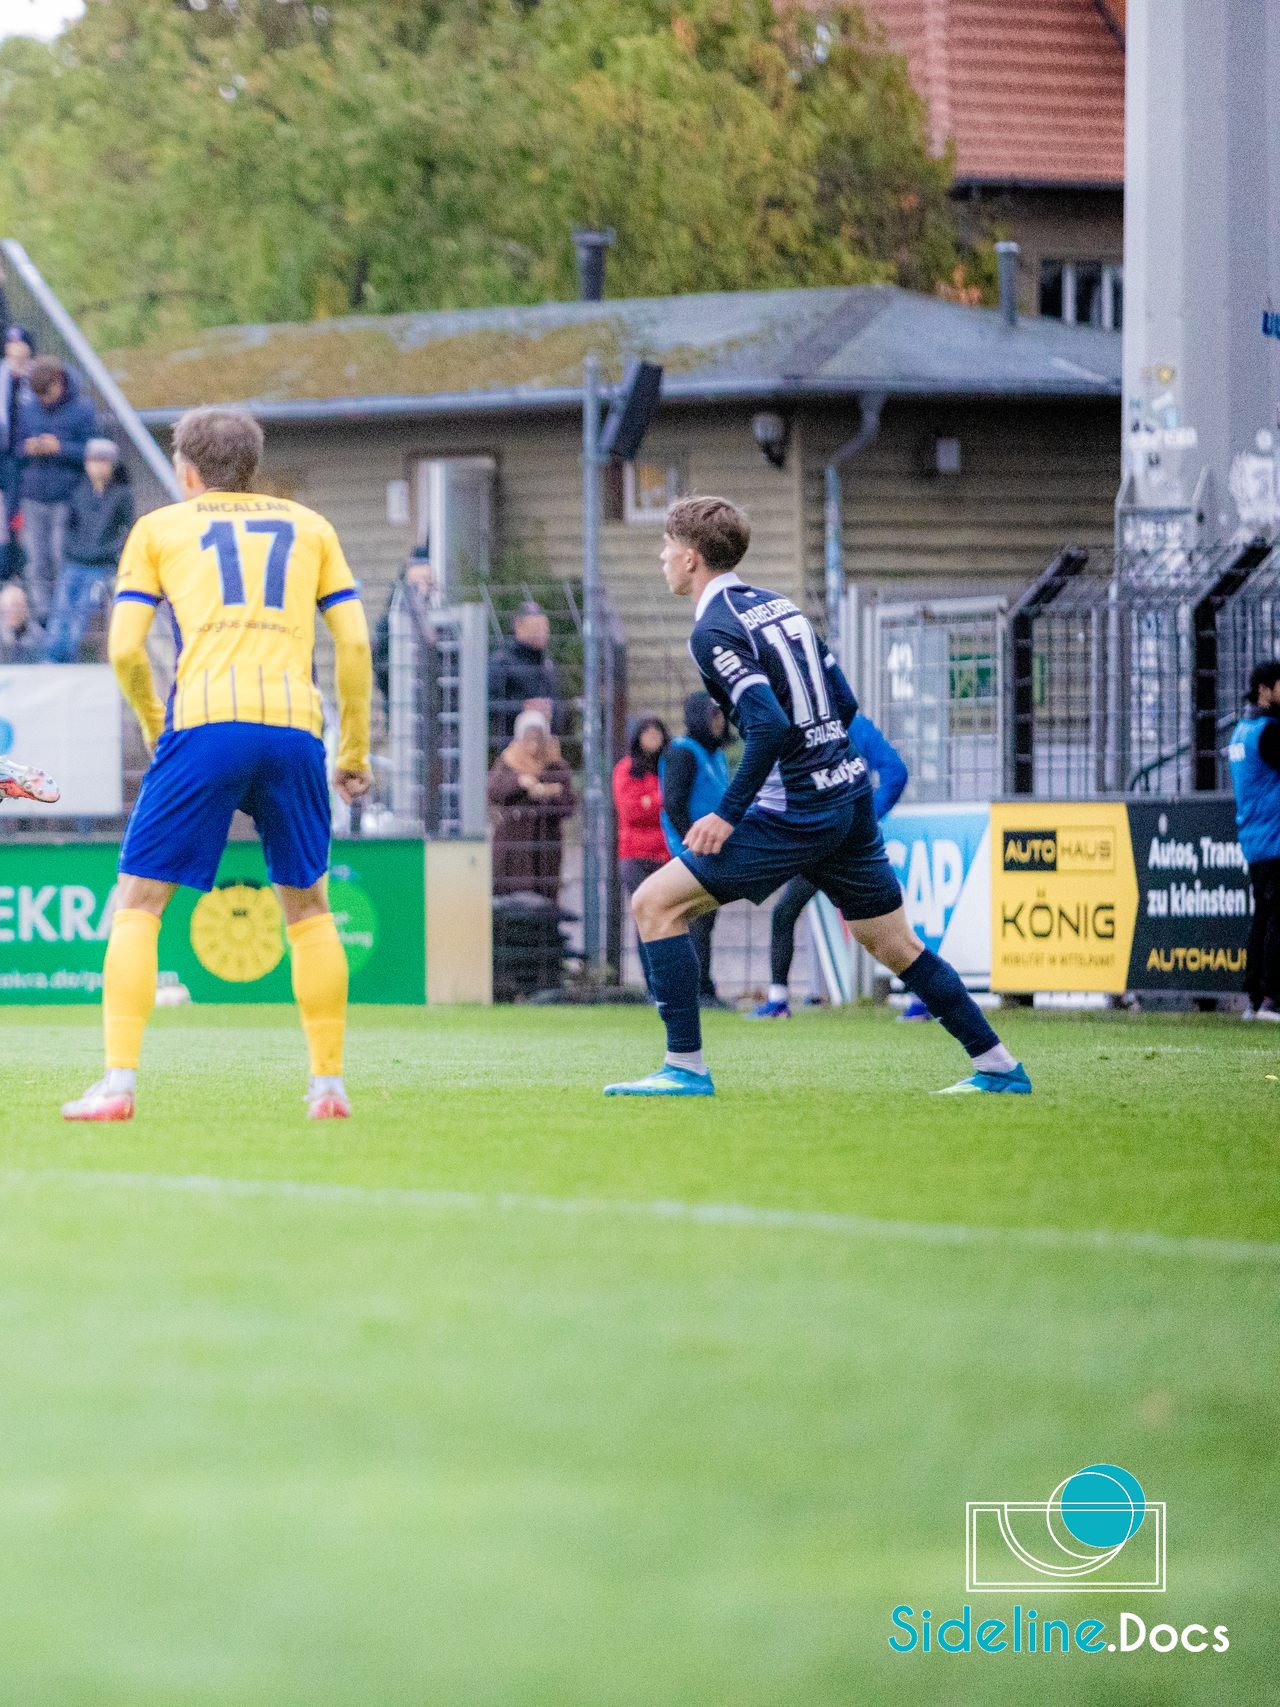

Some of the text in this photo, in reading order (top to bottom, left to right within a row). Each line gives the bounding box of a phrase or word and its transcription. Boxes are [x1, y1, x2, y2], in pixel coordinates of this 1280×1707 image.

[200, 520, 295, 610] 17
[739, 598, 800, 631] BABELSBE
[760, 615, 831, 728] 17
[810, 757, 866, 791] Katjes
[1148, 836, 1249, 875] Autos, Trans
[1001, 887, 1115, 940] KÖNIG
[1147, 889, 1168, 917] zu
[1170, 879, 1246, 917] kleinsten
[1146, 948, 1247, 972] AUTOHAU
